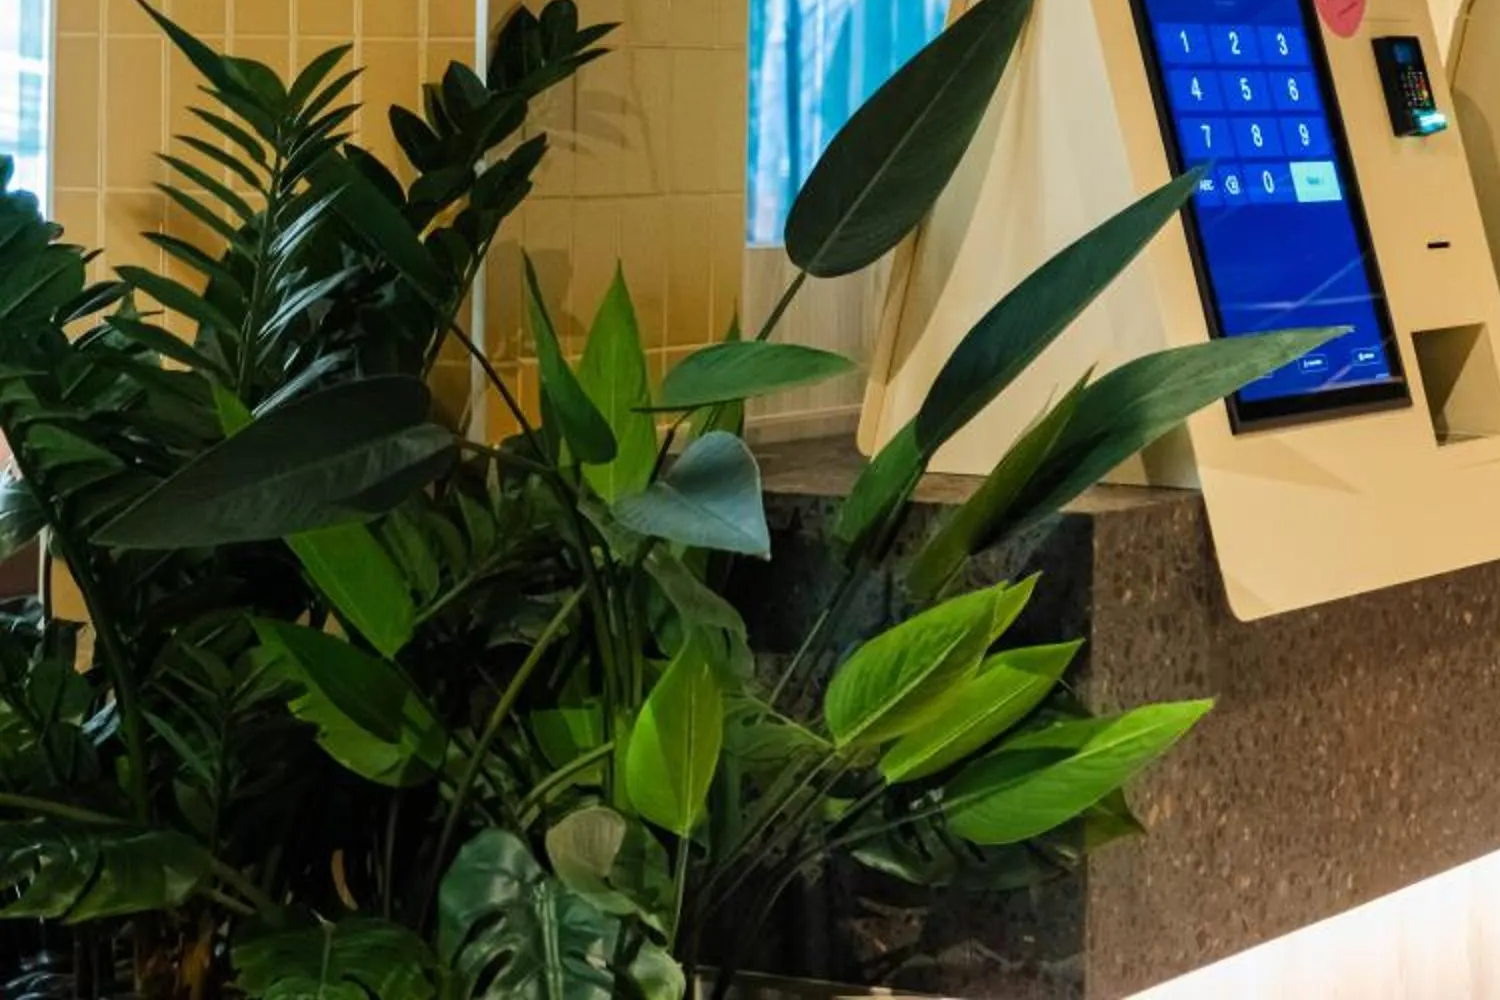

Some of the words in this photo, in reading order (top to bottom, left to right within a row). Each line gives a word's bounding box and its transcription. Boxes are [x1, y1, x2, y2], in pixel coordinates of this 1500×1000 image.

[1179, 30, 1190, 54] 1
[1228, 31, 1241, 55] 2
[1276, 32, 1289, 56] 3
[1191, 77, 1203, 101] 4
[1239, 77, 1253, 102] 5
[1287, 77, 1299, 102] 6
[1199, 124, 1211, 149] 7
[1250, 123, 1264, 148] 8
[1298, 123, 1311, 147] 9
[1262, 170, 1275, 194] 0
